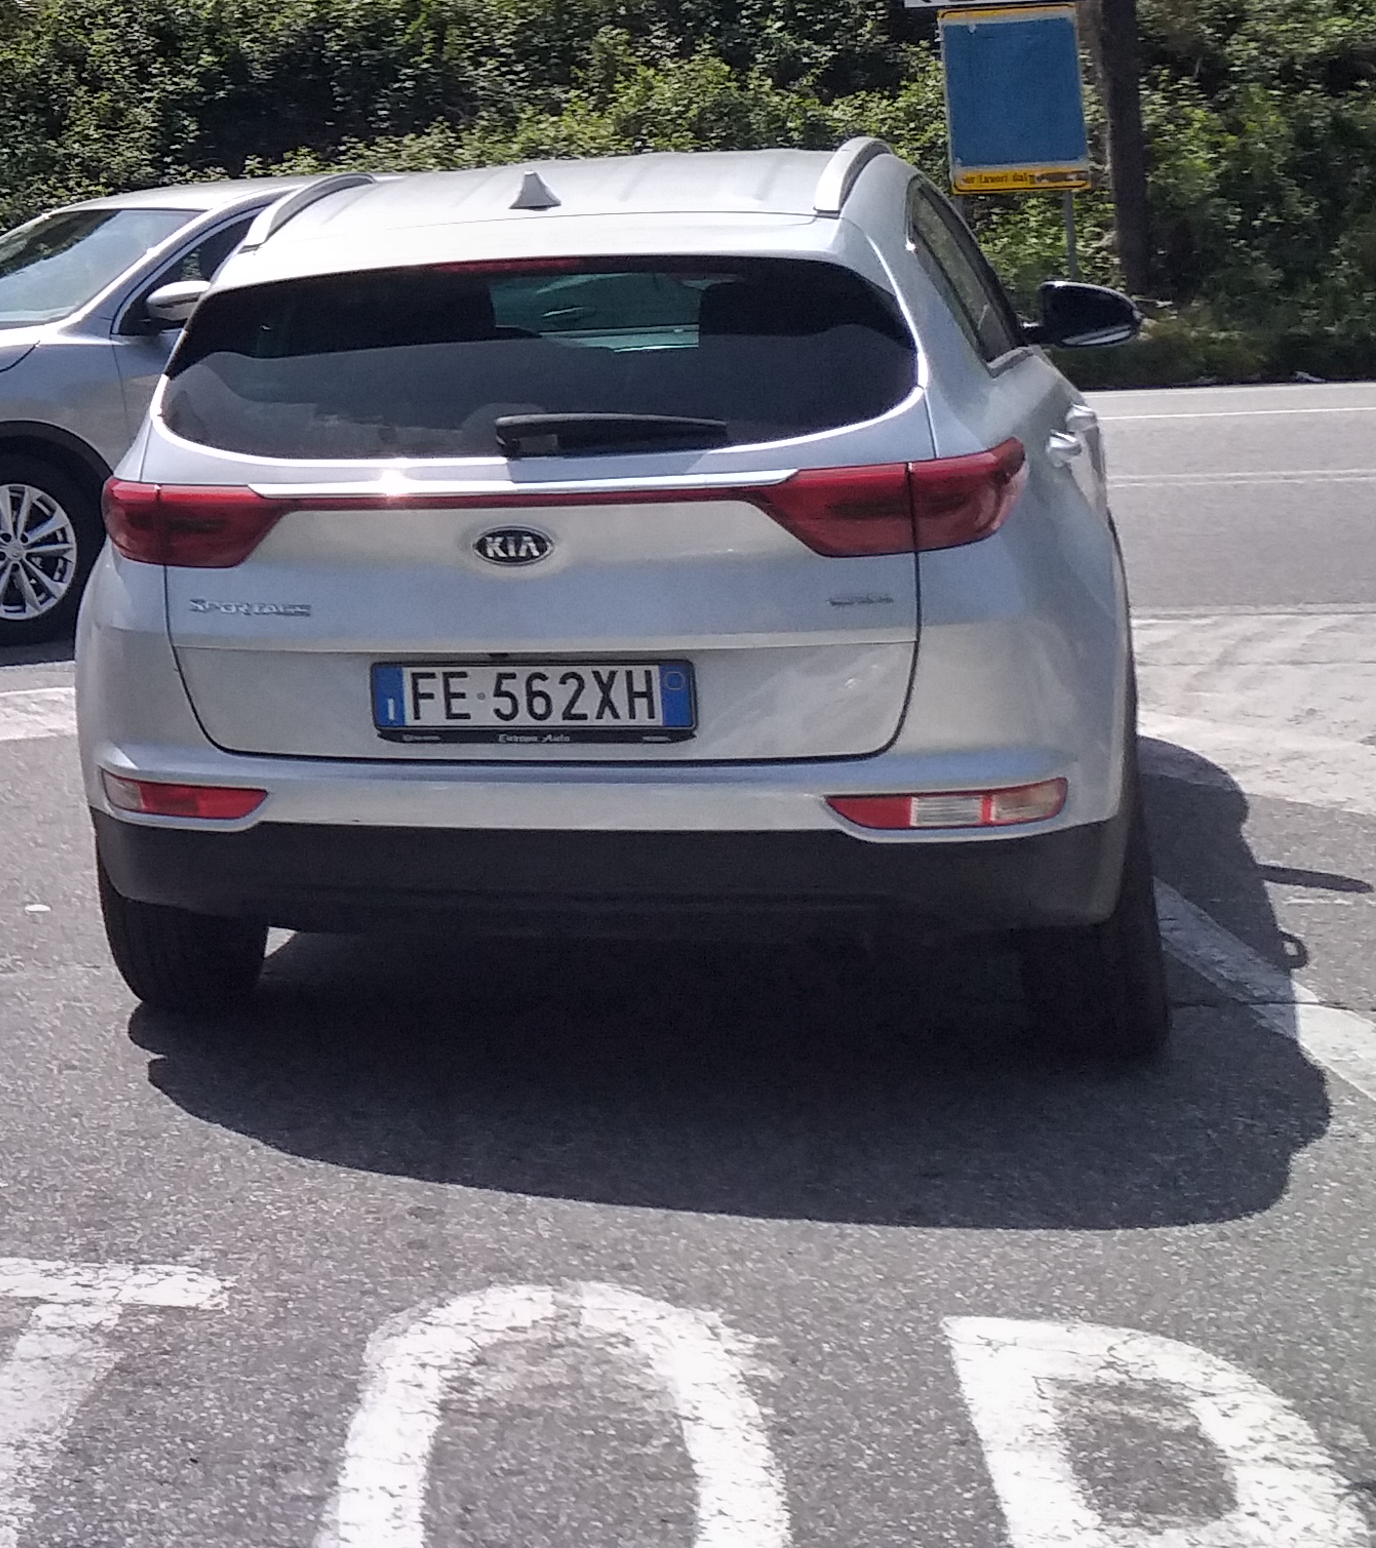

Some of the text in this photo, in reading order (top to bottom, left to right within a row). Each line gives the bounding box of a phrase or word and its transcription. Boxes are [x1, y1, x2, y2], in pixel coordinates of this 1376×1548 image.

[485, 536, 541, 557] KIA
[410, 671, 472, 721] FE
[492, 669, 656, 722] 562XH
